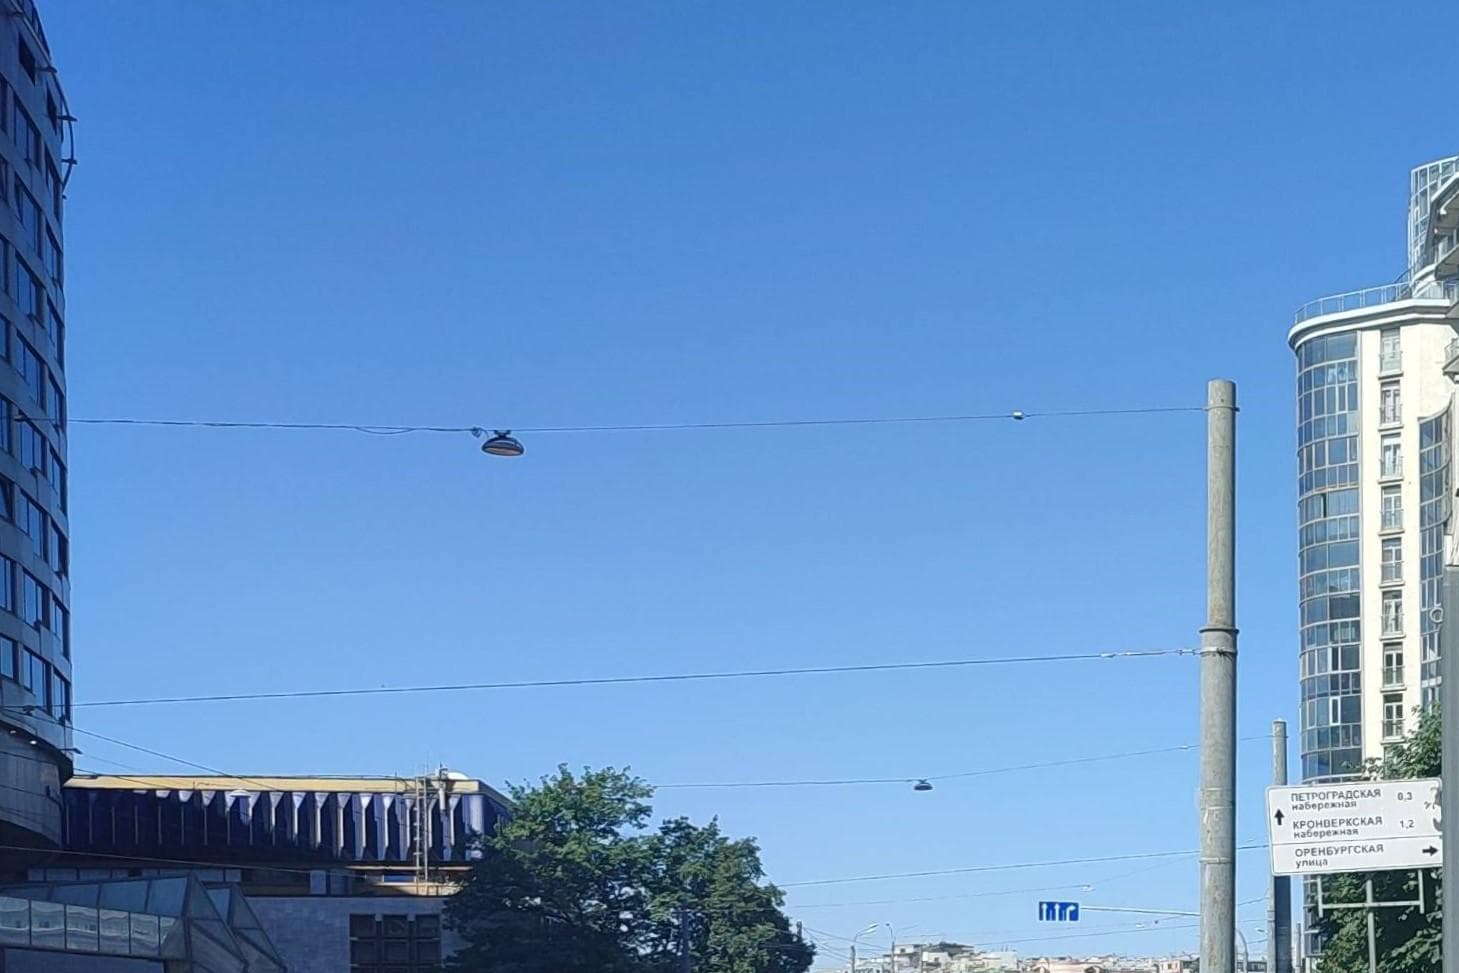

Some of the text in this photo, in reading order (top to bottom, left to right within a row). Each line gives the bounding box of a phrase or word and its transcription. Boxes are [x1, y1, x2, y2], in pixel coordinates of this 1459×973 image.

[1290, 788, 1382, 802] ПЕТРОГРАДСКАЯ
[1291, 800, 1357, 812] набережная
[1292, 816, 1383, 830] КРОНВЕРКСКАЯ
[1293, 828, 1359, 840] набережная
[1294, 843, 1384, 858] ОРЕНБУРГСКАЯ
[1295, 858, 1329, 869] улица
